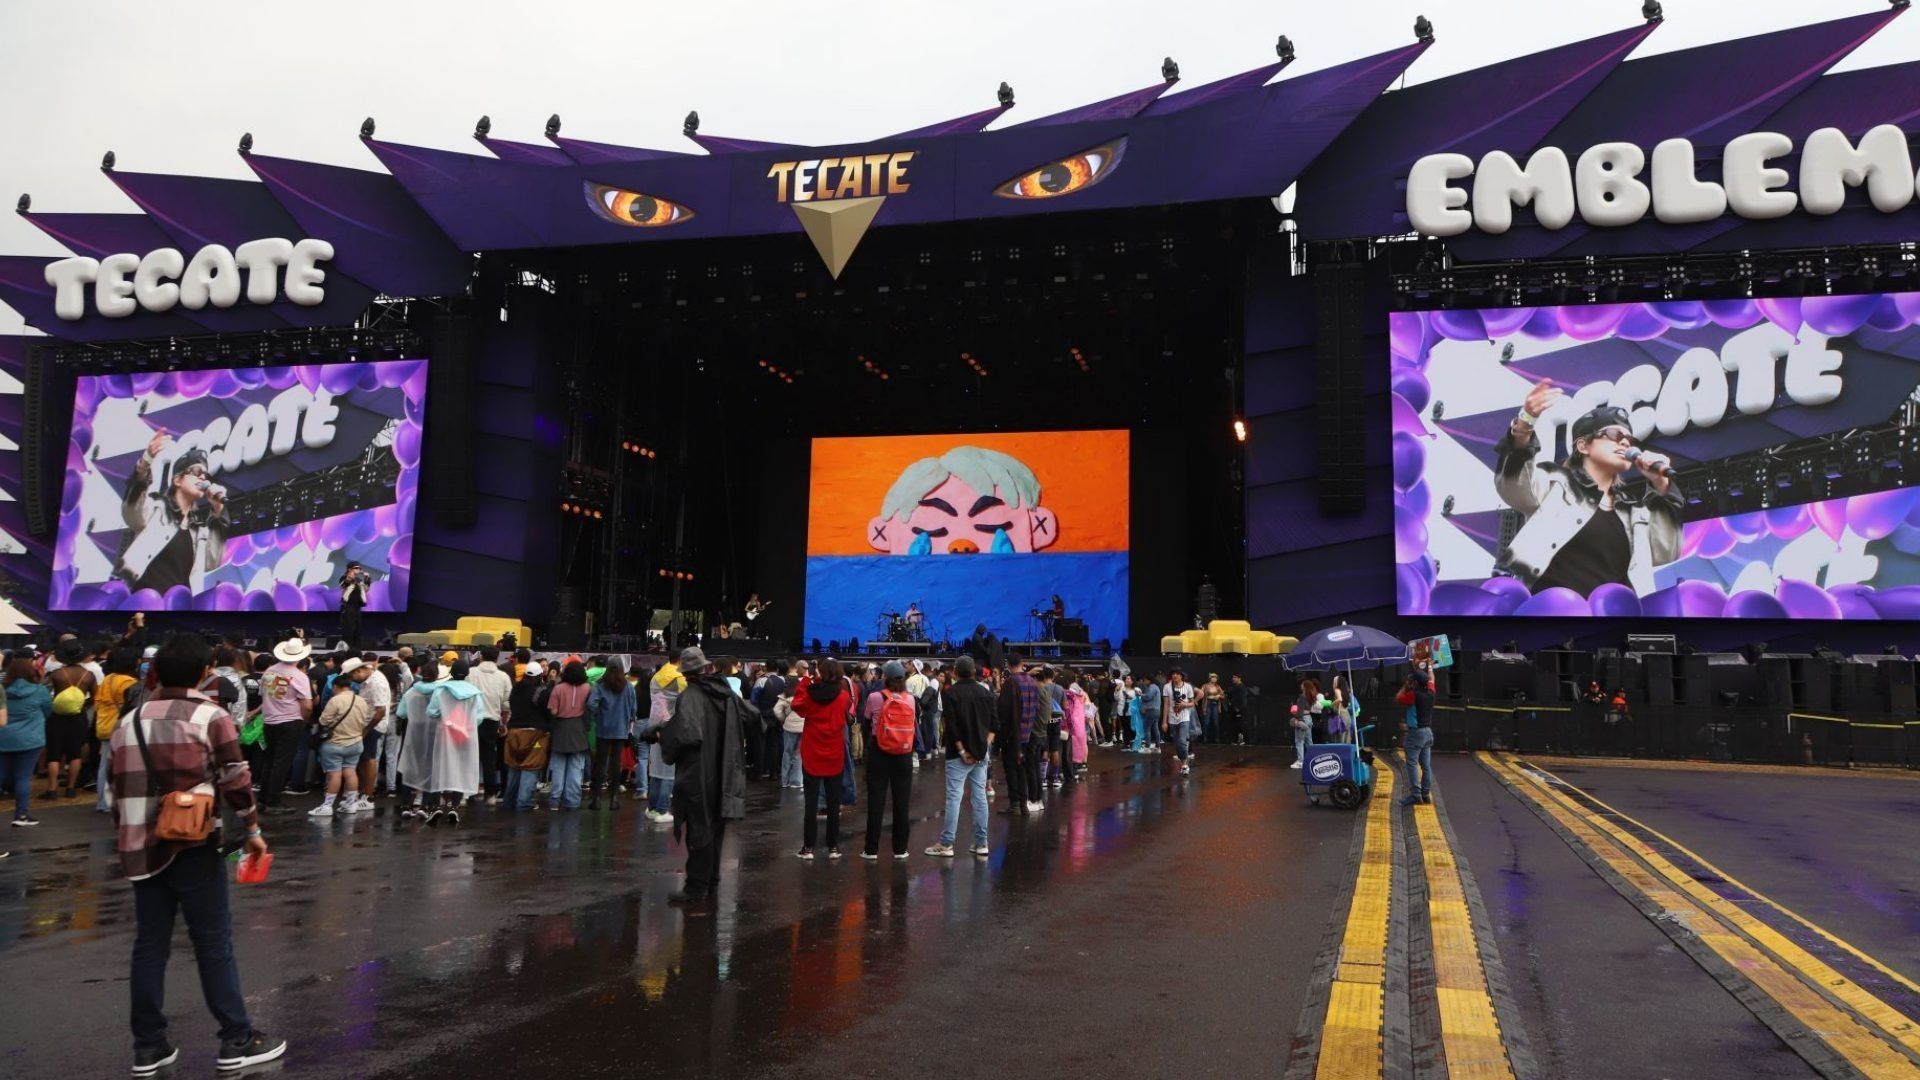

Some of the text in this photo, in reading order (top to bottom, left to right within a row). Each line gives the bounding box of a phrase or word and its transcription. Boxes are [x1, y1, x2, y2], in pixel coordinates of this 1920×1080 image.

[767, 151, 915, 203] TECATE
[1406, 124, 1920, 236] EMBLEM
[44, 237, 335, 321] TECATE
